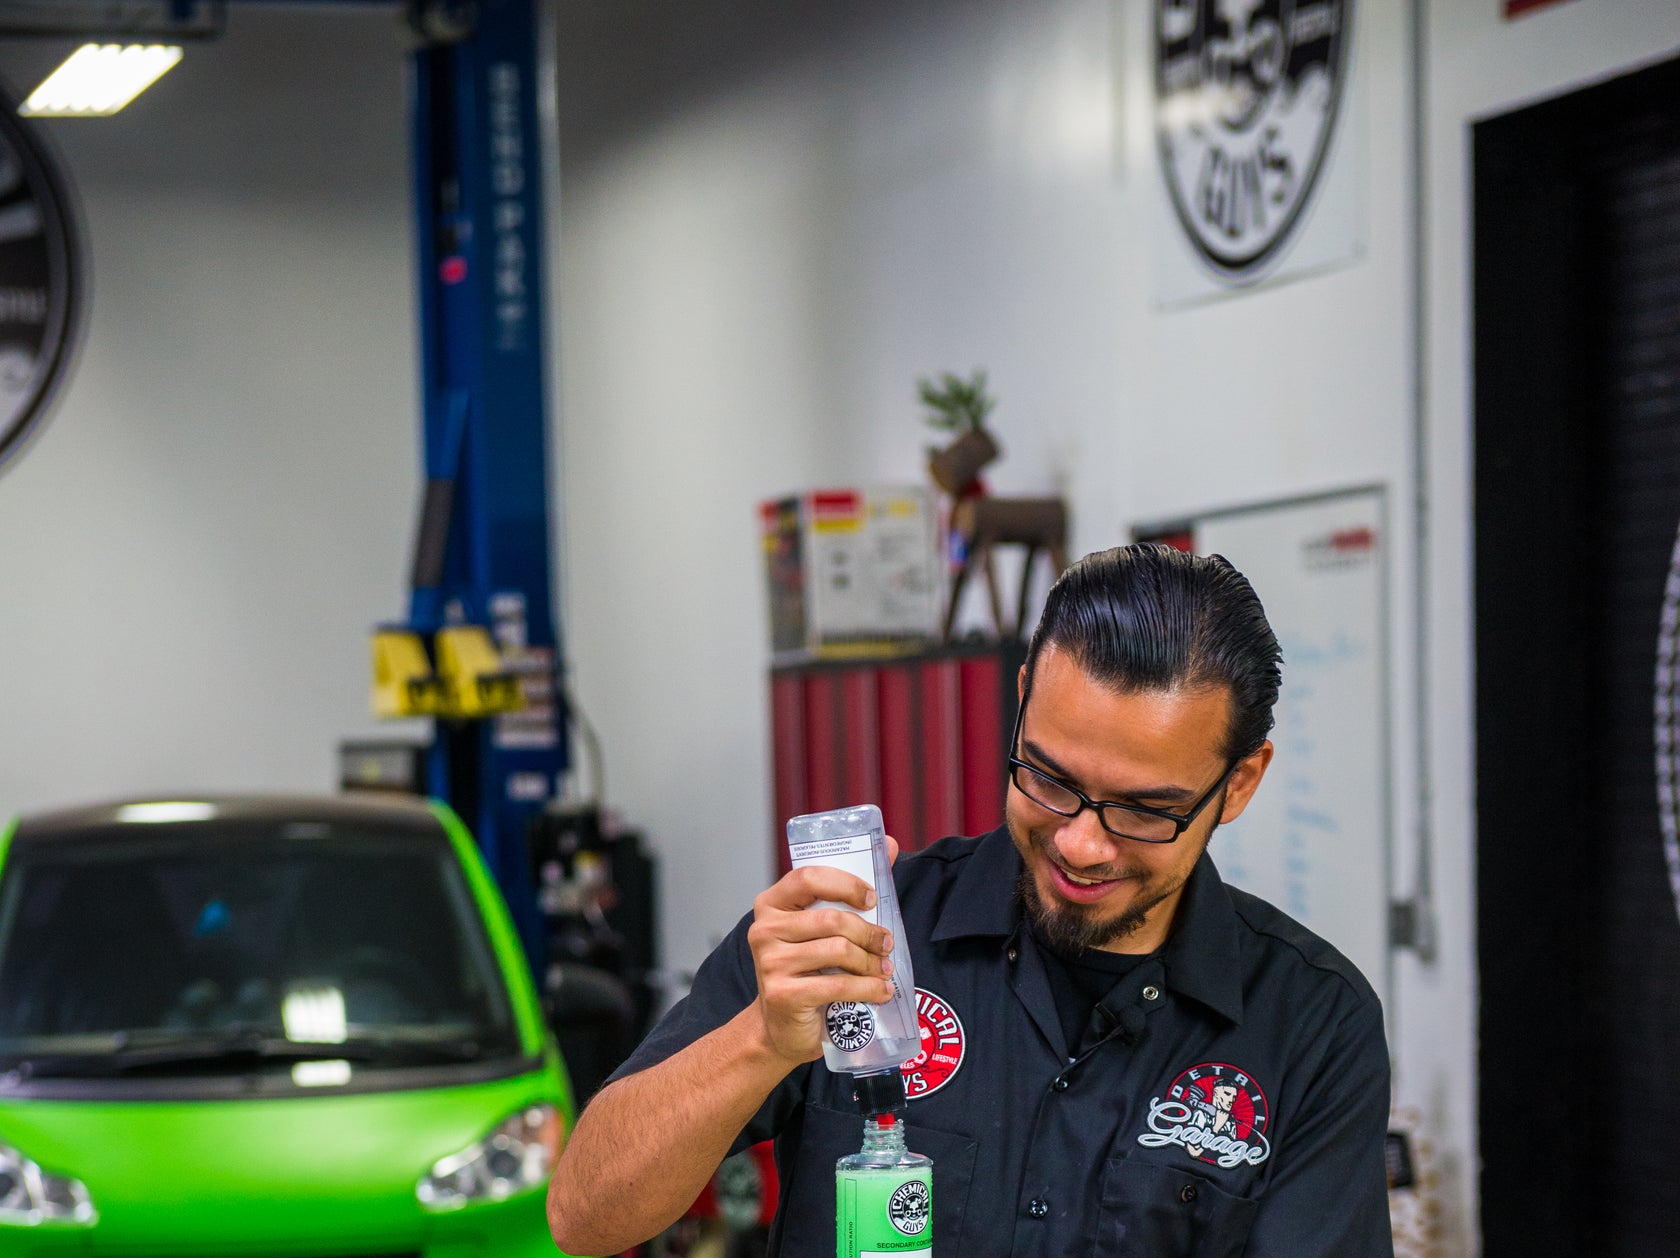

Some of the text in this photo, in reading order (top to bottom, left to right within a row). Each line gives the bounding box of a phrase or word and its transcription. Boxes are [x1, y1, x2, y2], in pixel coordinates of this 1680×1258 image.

[828, 1019, 872, 1050] CHEMICAL
[932, 1053, 958, 1065] LIFESTYLE
[902, 1072, 928, 1095] YS
[1170, 1065, 1266, 1126] DETAIL
[1137, 1097, 1271, 1169] Garage
[892, 1183, 929, 1211] CHEMICAL
[902, 1220, 924, 1232] GUYS
[877, 1241, 916, 1249] SECONDARY
